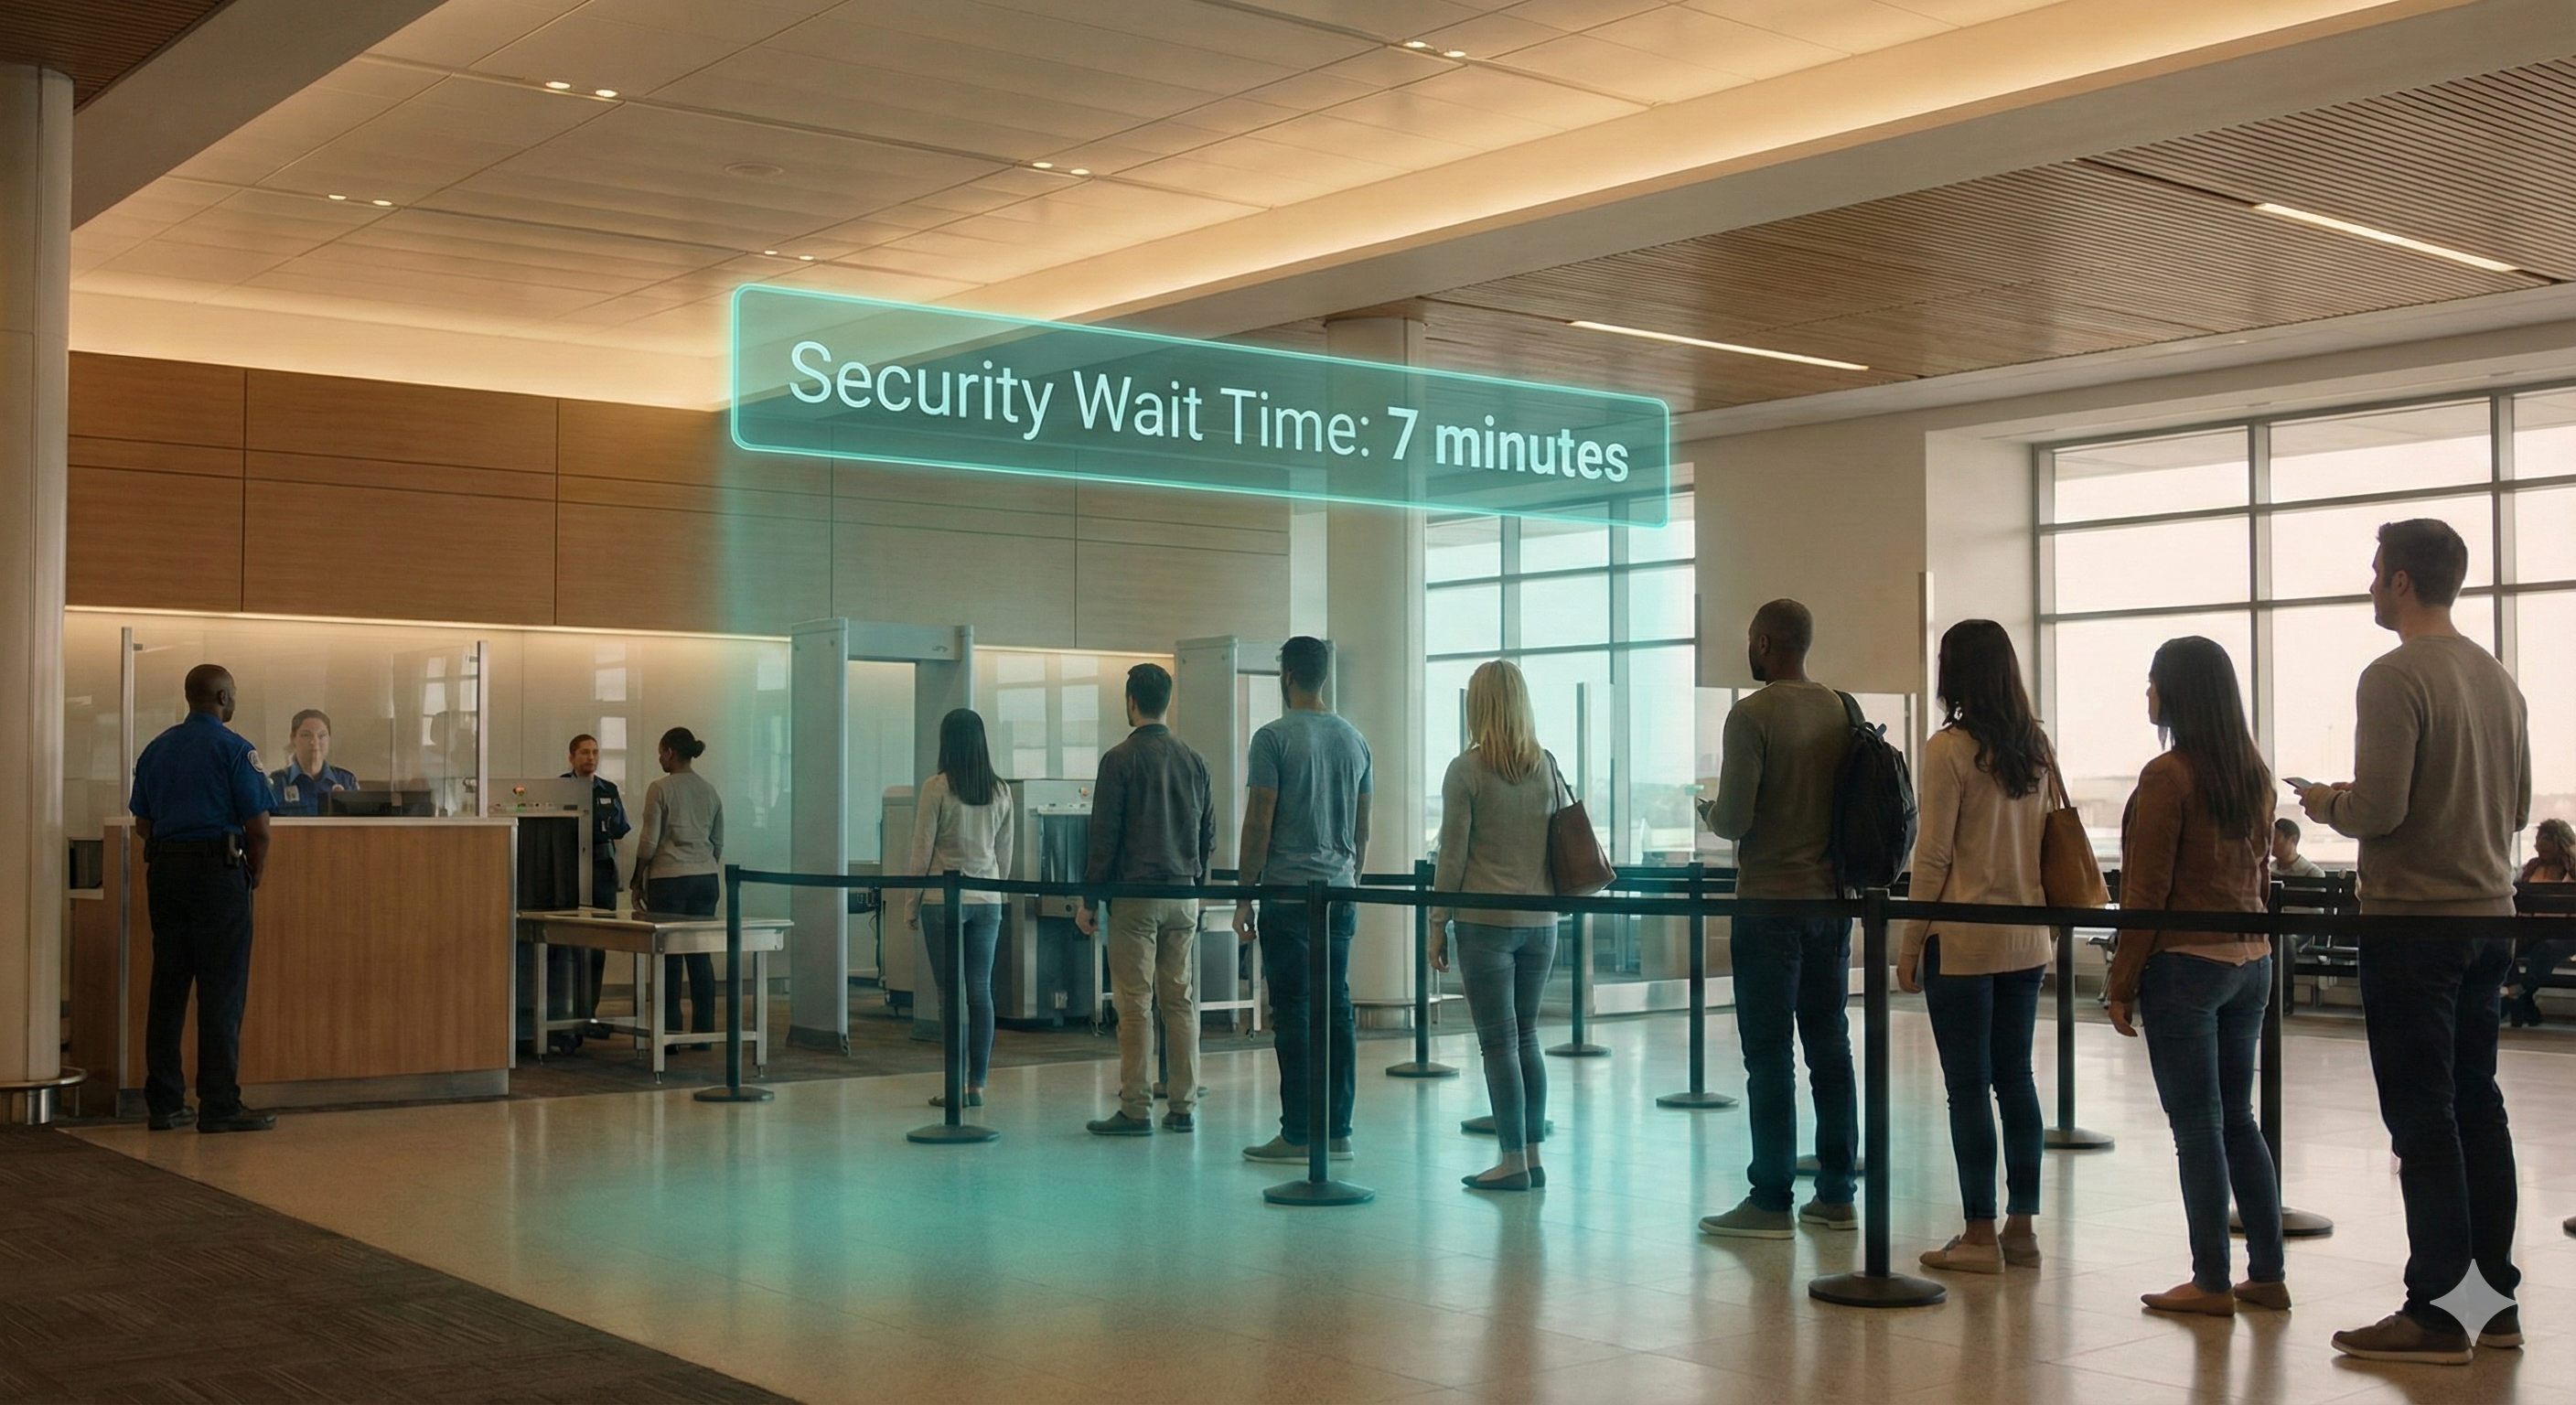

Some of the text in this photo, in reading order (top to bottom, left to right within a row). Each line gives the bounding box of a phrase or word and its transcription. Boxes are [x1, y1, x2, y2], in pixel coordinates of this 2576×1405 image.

[788, 339, 1629, 483] Security Wait Time: 7 minutes
